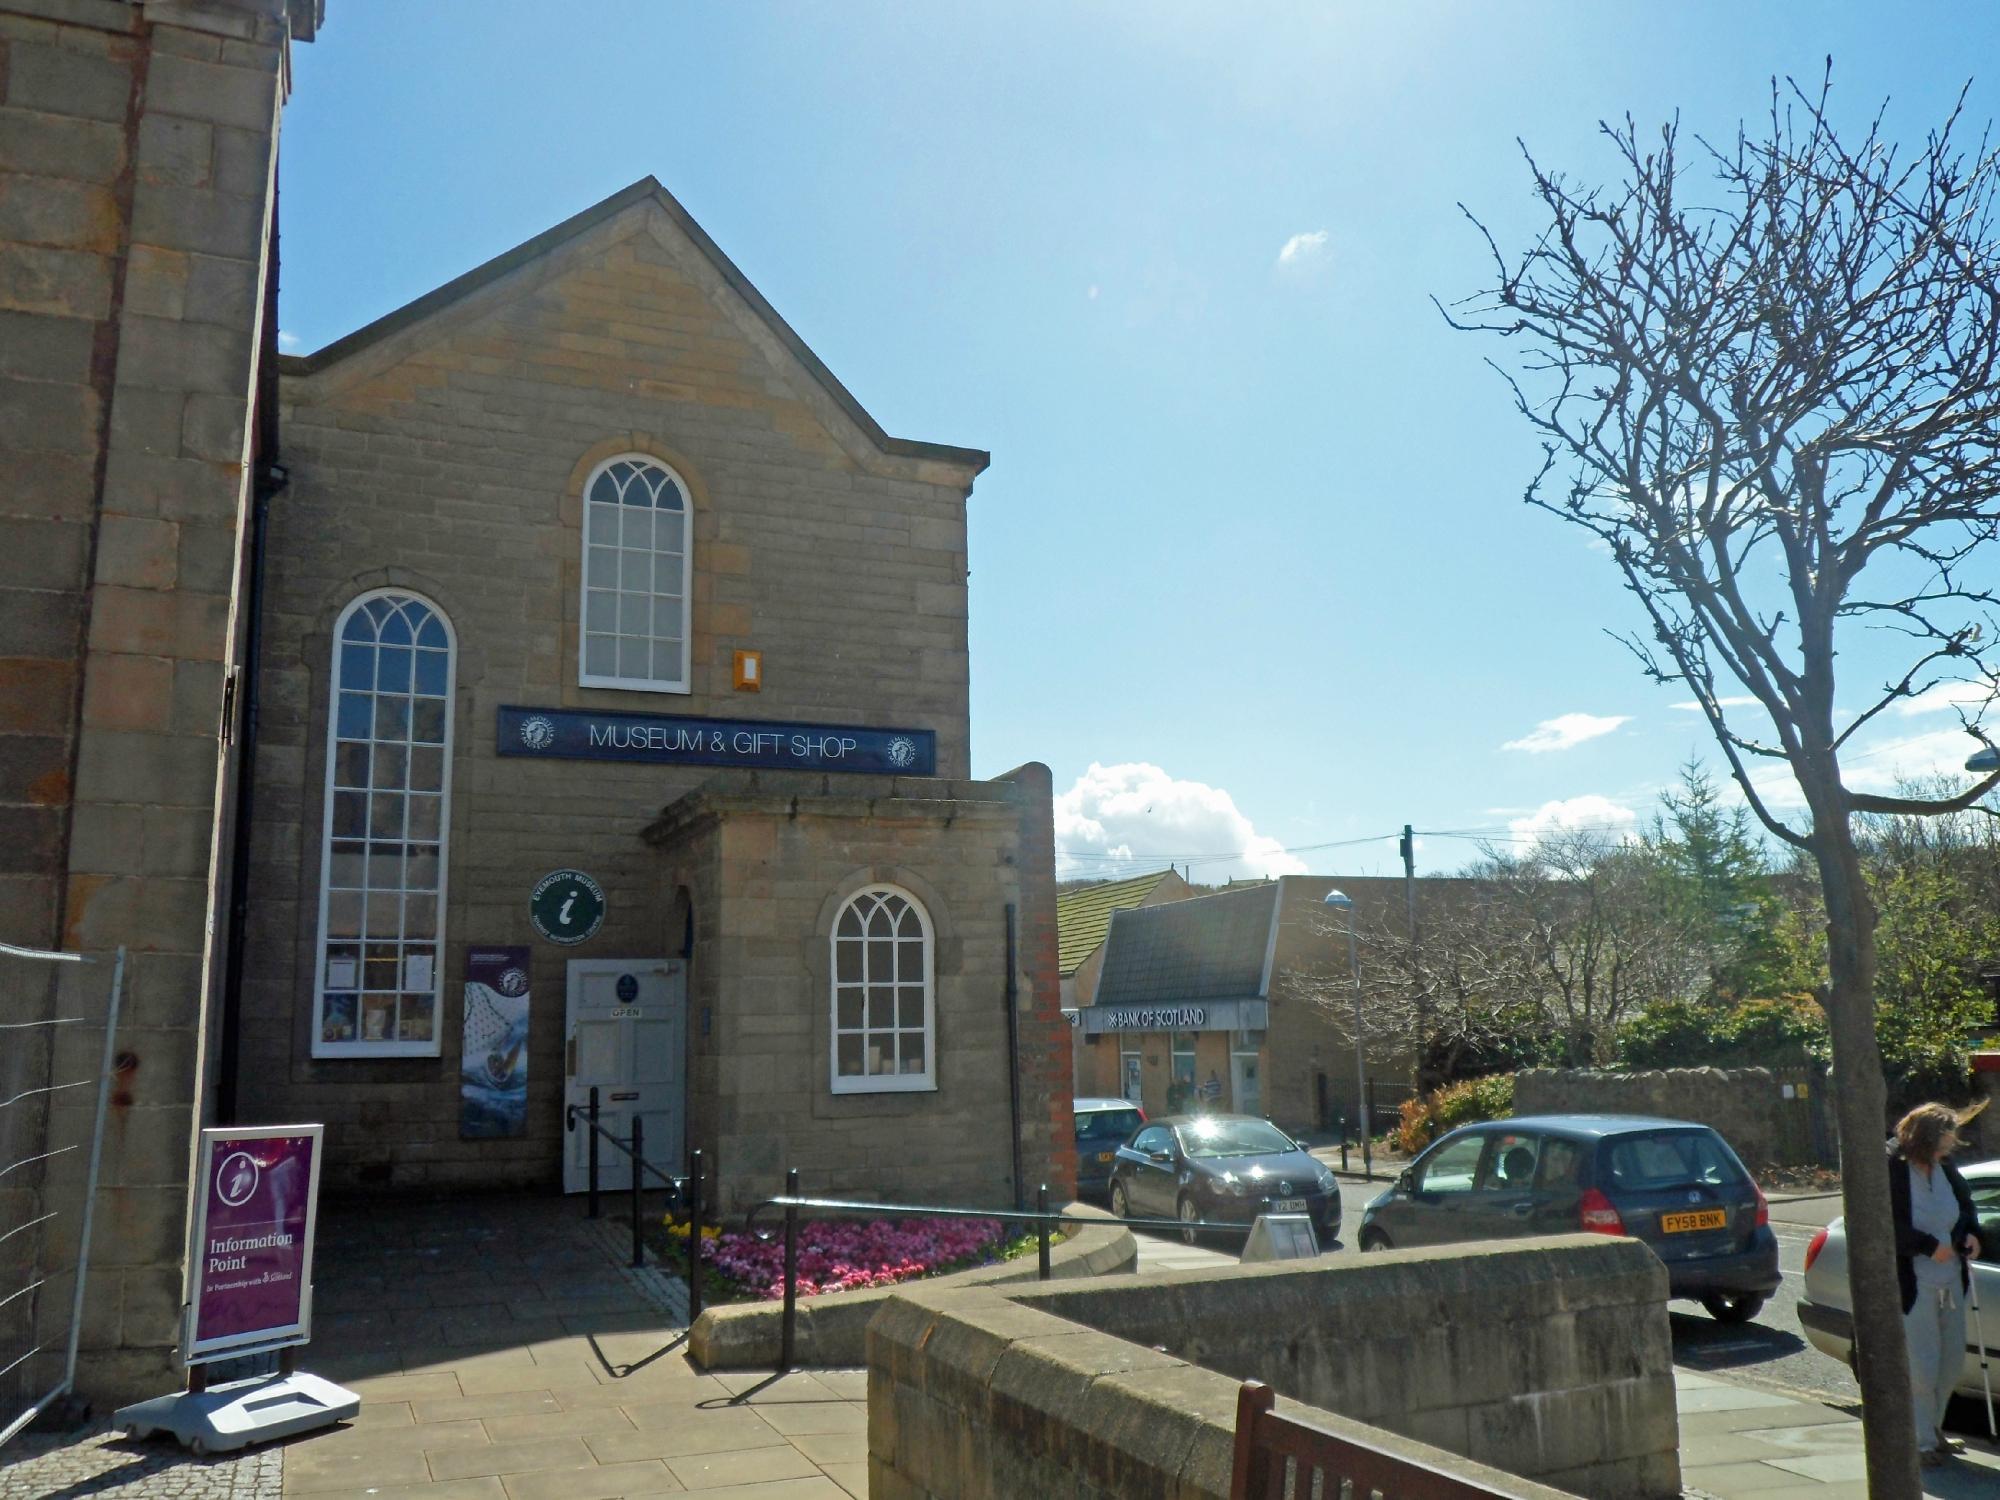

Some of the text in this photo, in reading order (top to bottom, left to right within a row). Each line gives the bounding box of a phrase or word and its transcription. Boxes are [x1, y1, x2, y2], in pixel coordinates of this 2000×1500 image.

[590, 724, 857, 758] MUSEUM & GIFT SHOP
[532, 873, 602, 902] EYEMOUTH MUSEUM
[612, 1008, 640, 1017] OPEN
[1118, 1008, 1204, 1027] BANK OF SCOTLAND
[1666, 1212, 1721, 1231] FY58 BNK
[210, 1233, 293, 1254] Information
[207, 1256, 246, 1273] Point
